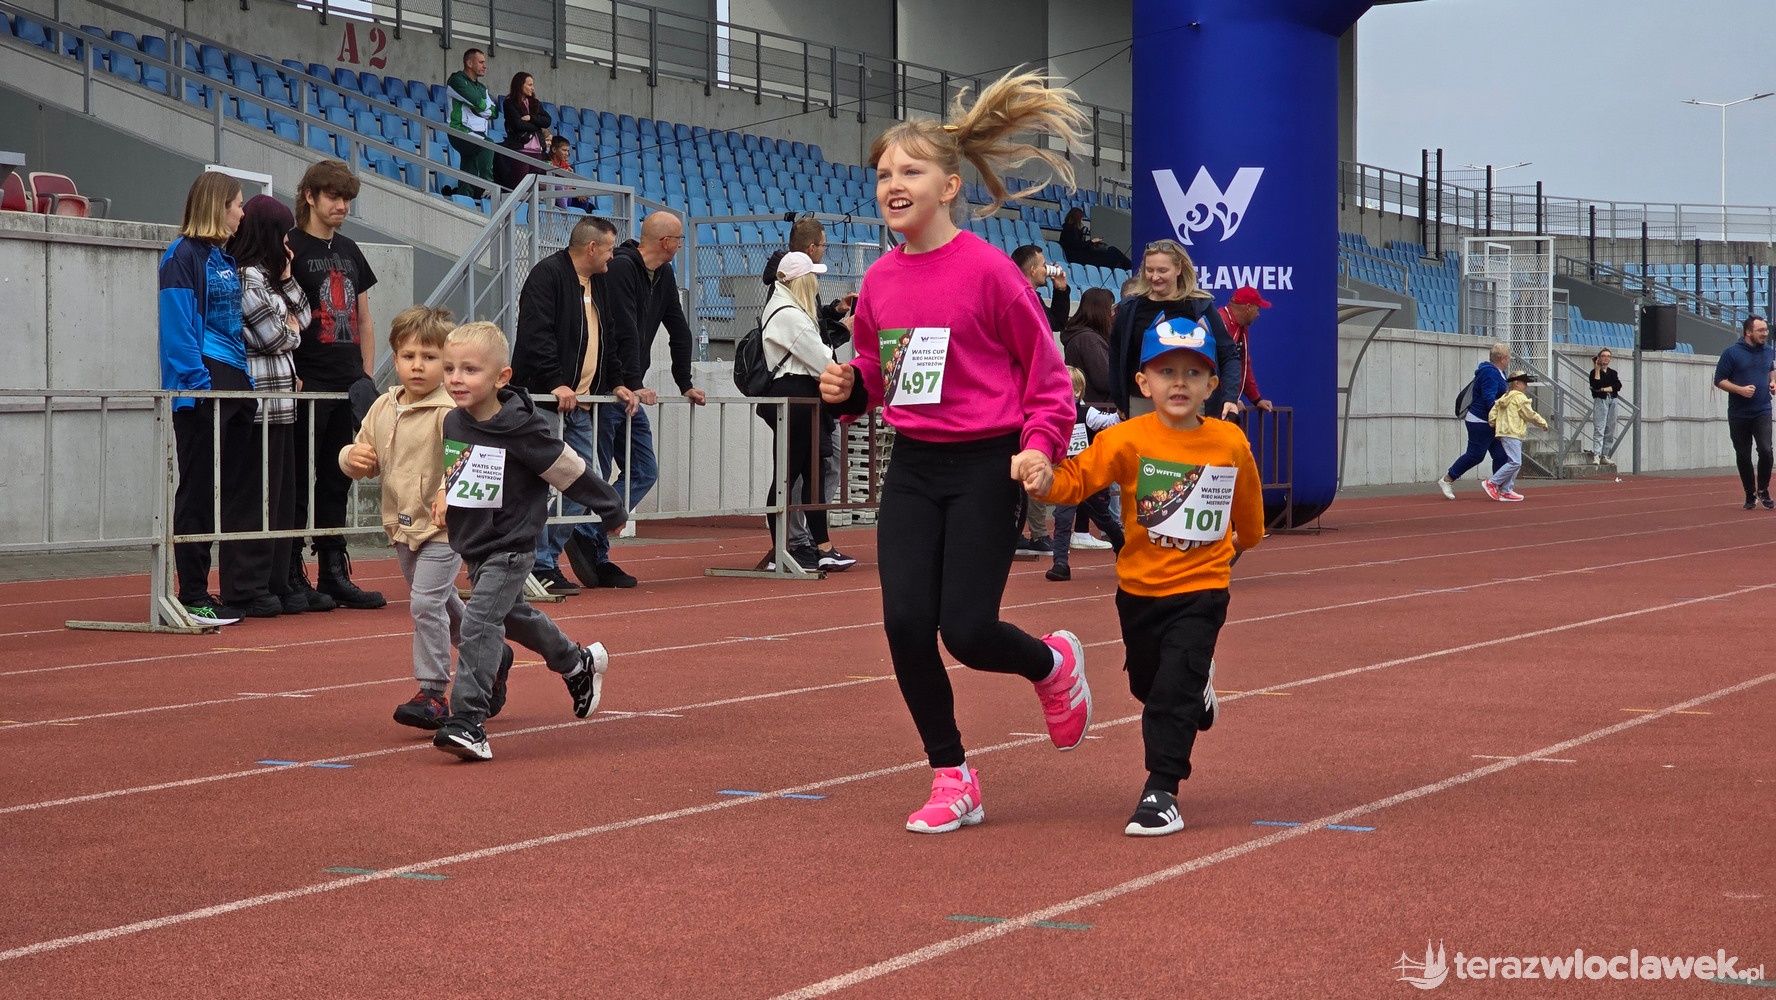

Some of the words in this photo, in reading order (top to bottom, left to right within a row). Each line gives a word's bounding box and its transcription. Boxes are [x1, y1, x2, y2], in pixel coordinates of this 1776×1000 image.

[901, 371, 941, 395] 497
[1156, 468, 1182, 478] WATIS
[456, 480, 500, 502] 247
[1184, 507, 1223, 532] 101
